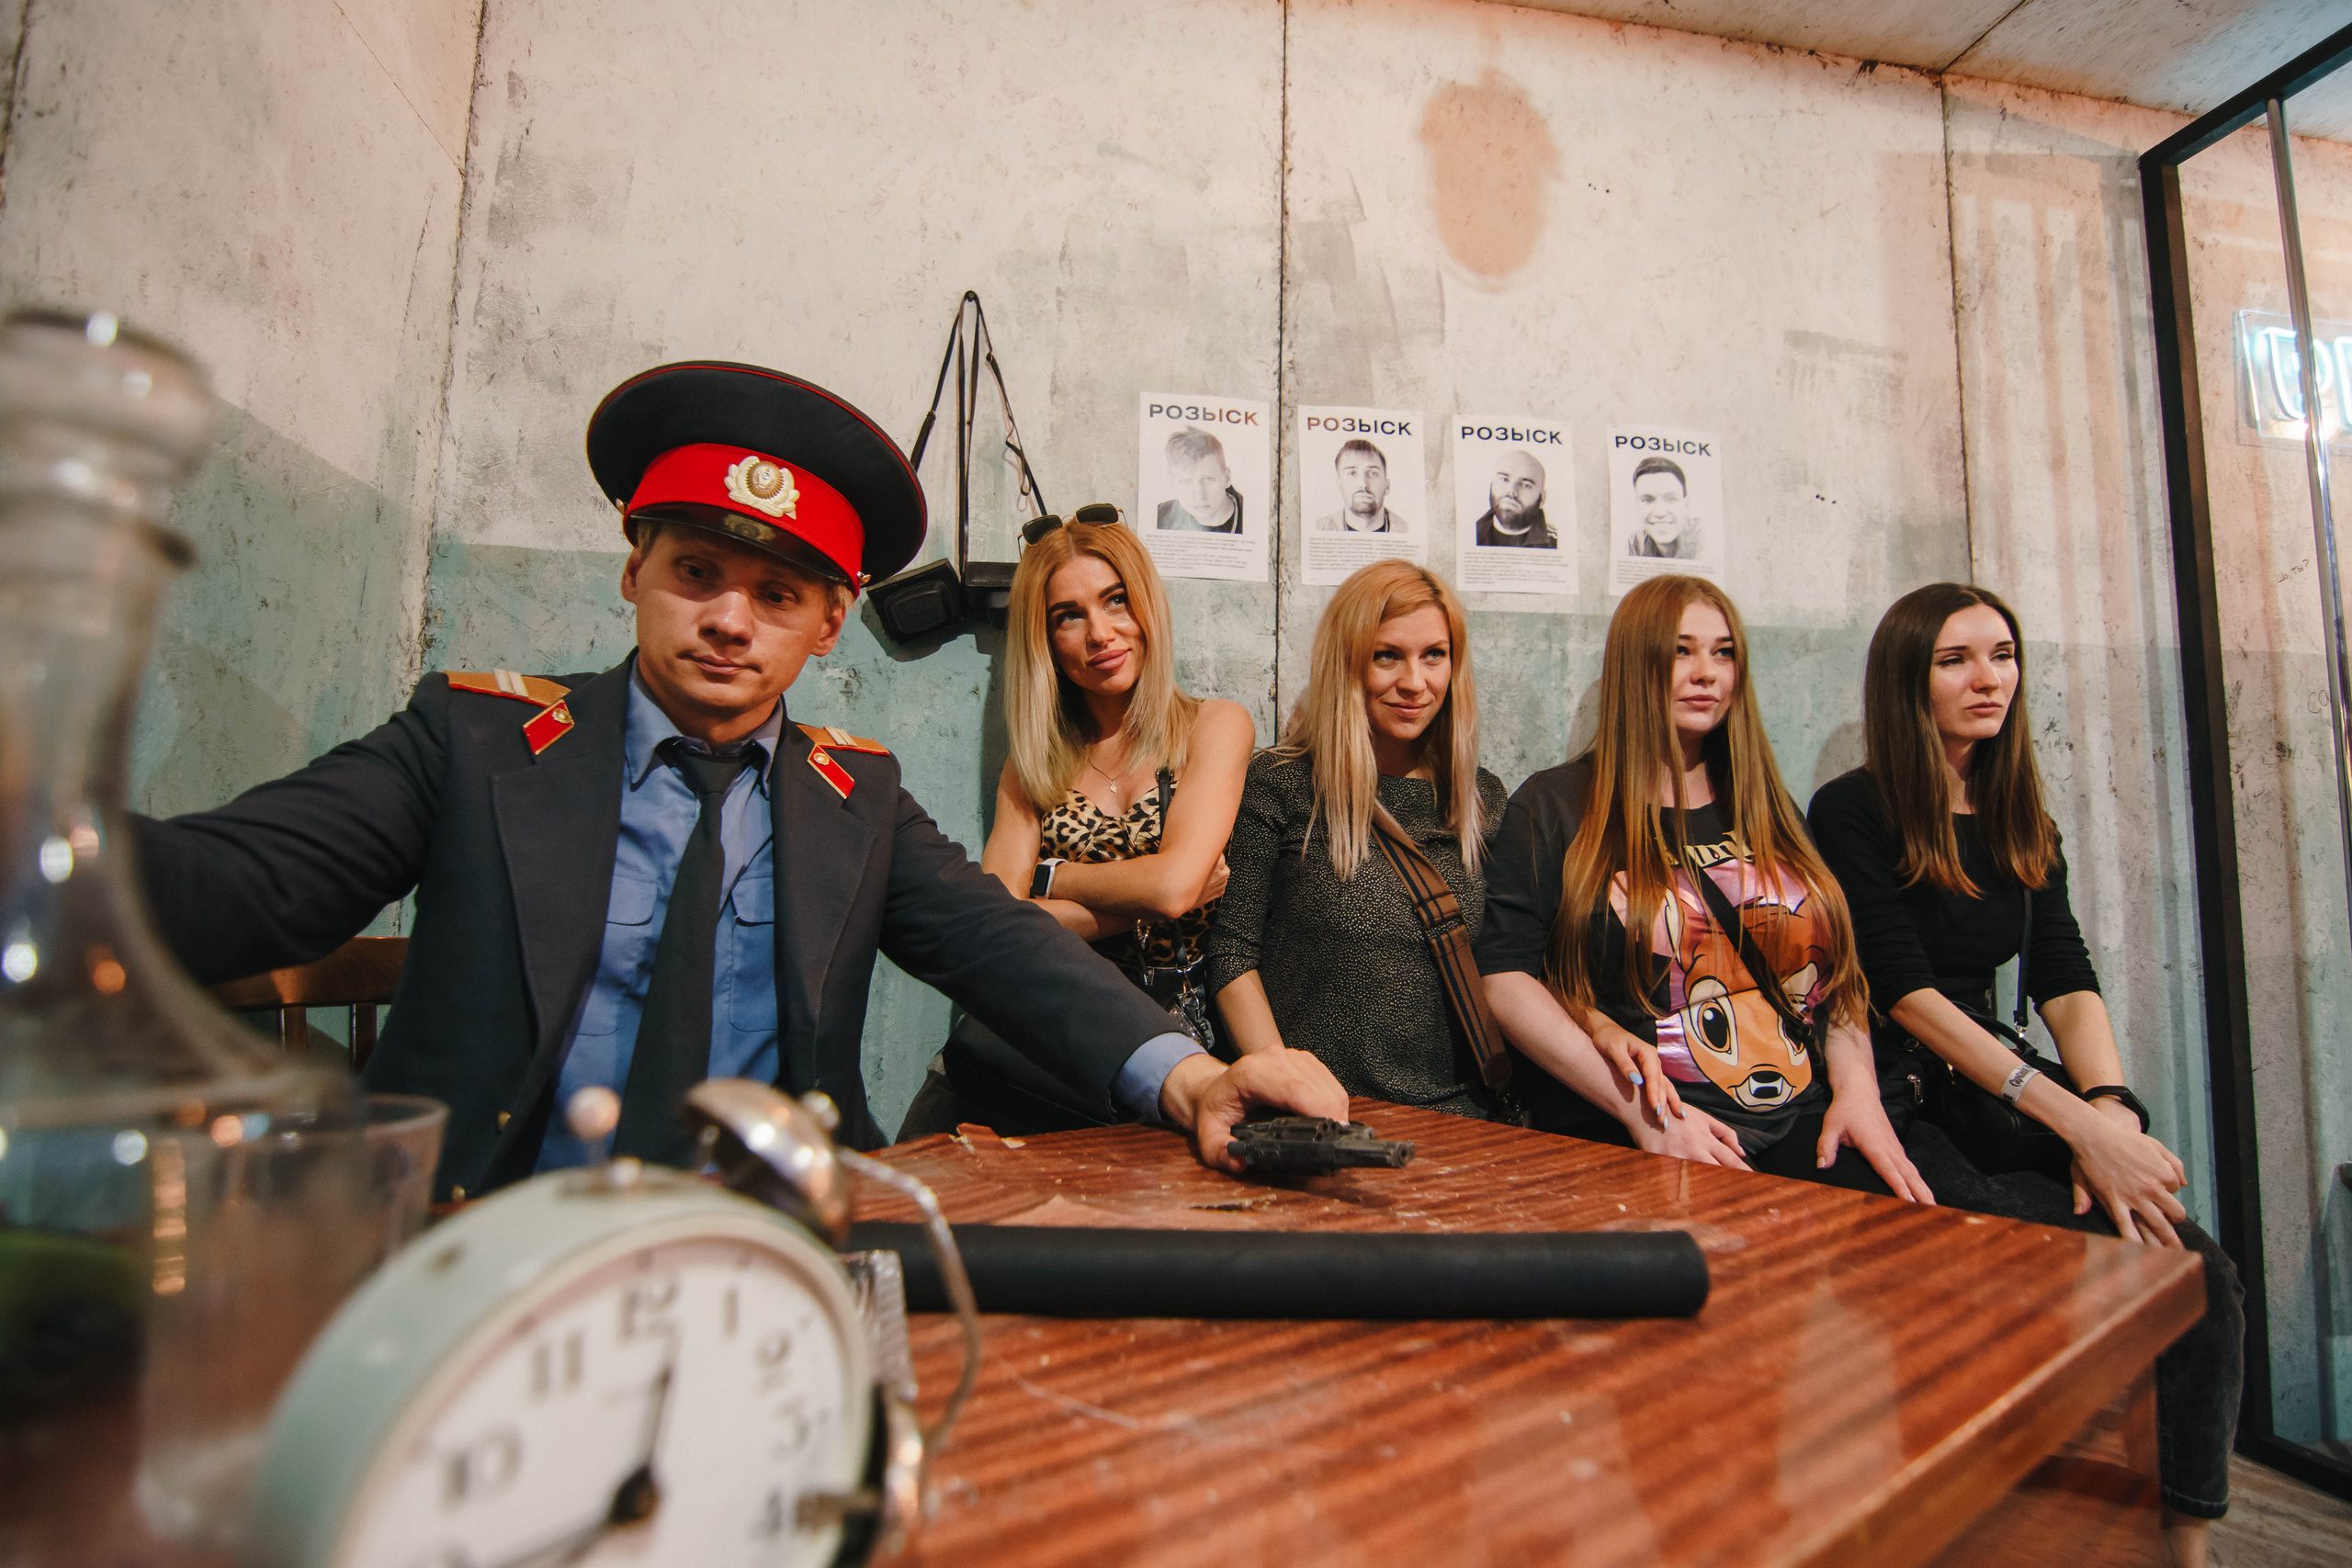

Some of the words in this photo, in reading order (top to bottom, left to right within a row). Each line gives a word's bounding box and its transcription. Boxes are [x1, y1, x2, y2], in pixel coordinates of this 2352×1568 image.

[1149, 403, 1259, 426] РОЗЫСК
[1307, 417, 1412, 436] РОЗЫСК
[1461, 426, 1563, 445] РОЗЫСК
[1614, 435, 1712, 457] РОЗЫСК
[526, 1327, 586, 1405] 11
